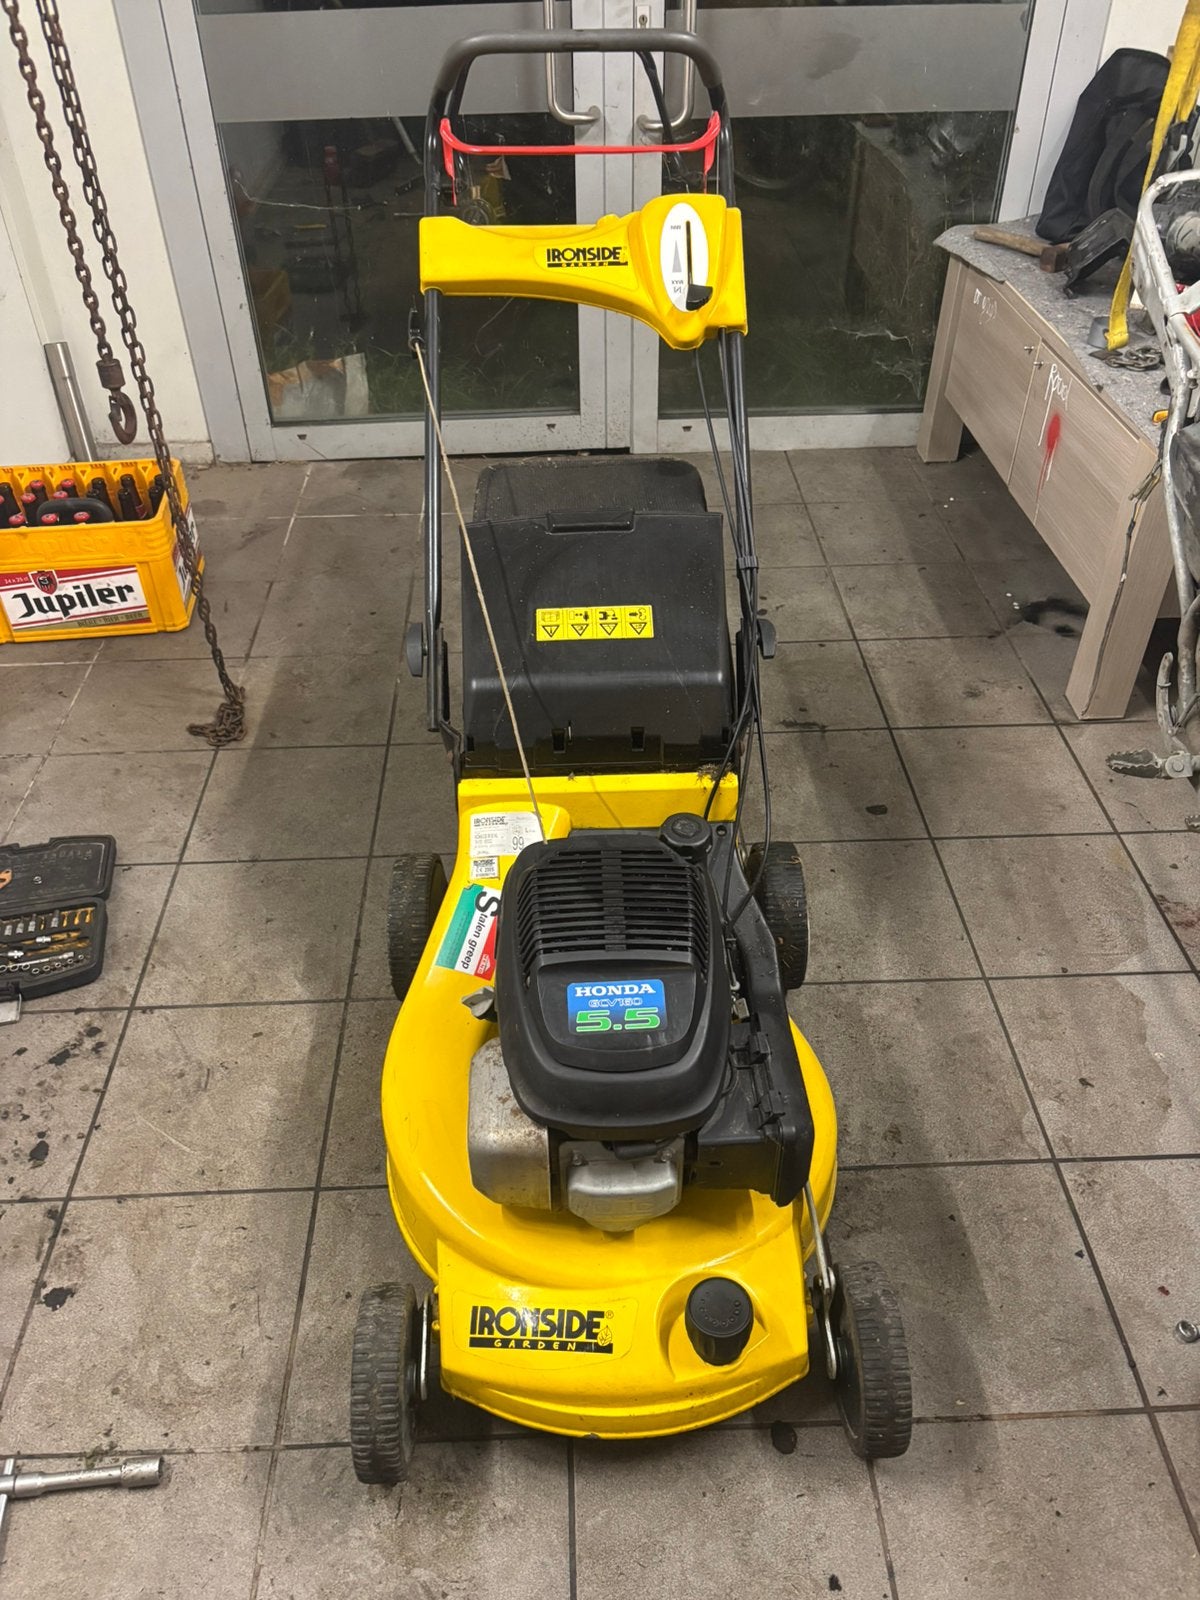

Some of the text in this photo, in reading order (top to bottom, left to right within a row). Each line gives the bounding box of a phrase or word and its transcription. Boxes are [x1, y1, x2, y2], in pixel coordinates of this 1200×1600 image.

[547, 246, 622, 261] IRONSIDE
[11, 583, 135, 619] Jupiler
[473, 891, 500, 938] Stalen
[461, 939, 477, 970] greep
[575, 983, 656, 997] HONDA
[588, 997, 643, 1008] GCV160
[576, 1007, 661, 1032] 5.5
[470, 1305, 605, 1340] IRONSIDE
[494, 1339, 576, 1351] GARDEN
